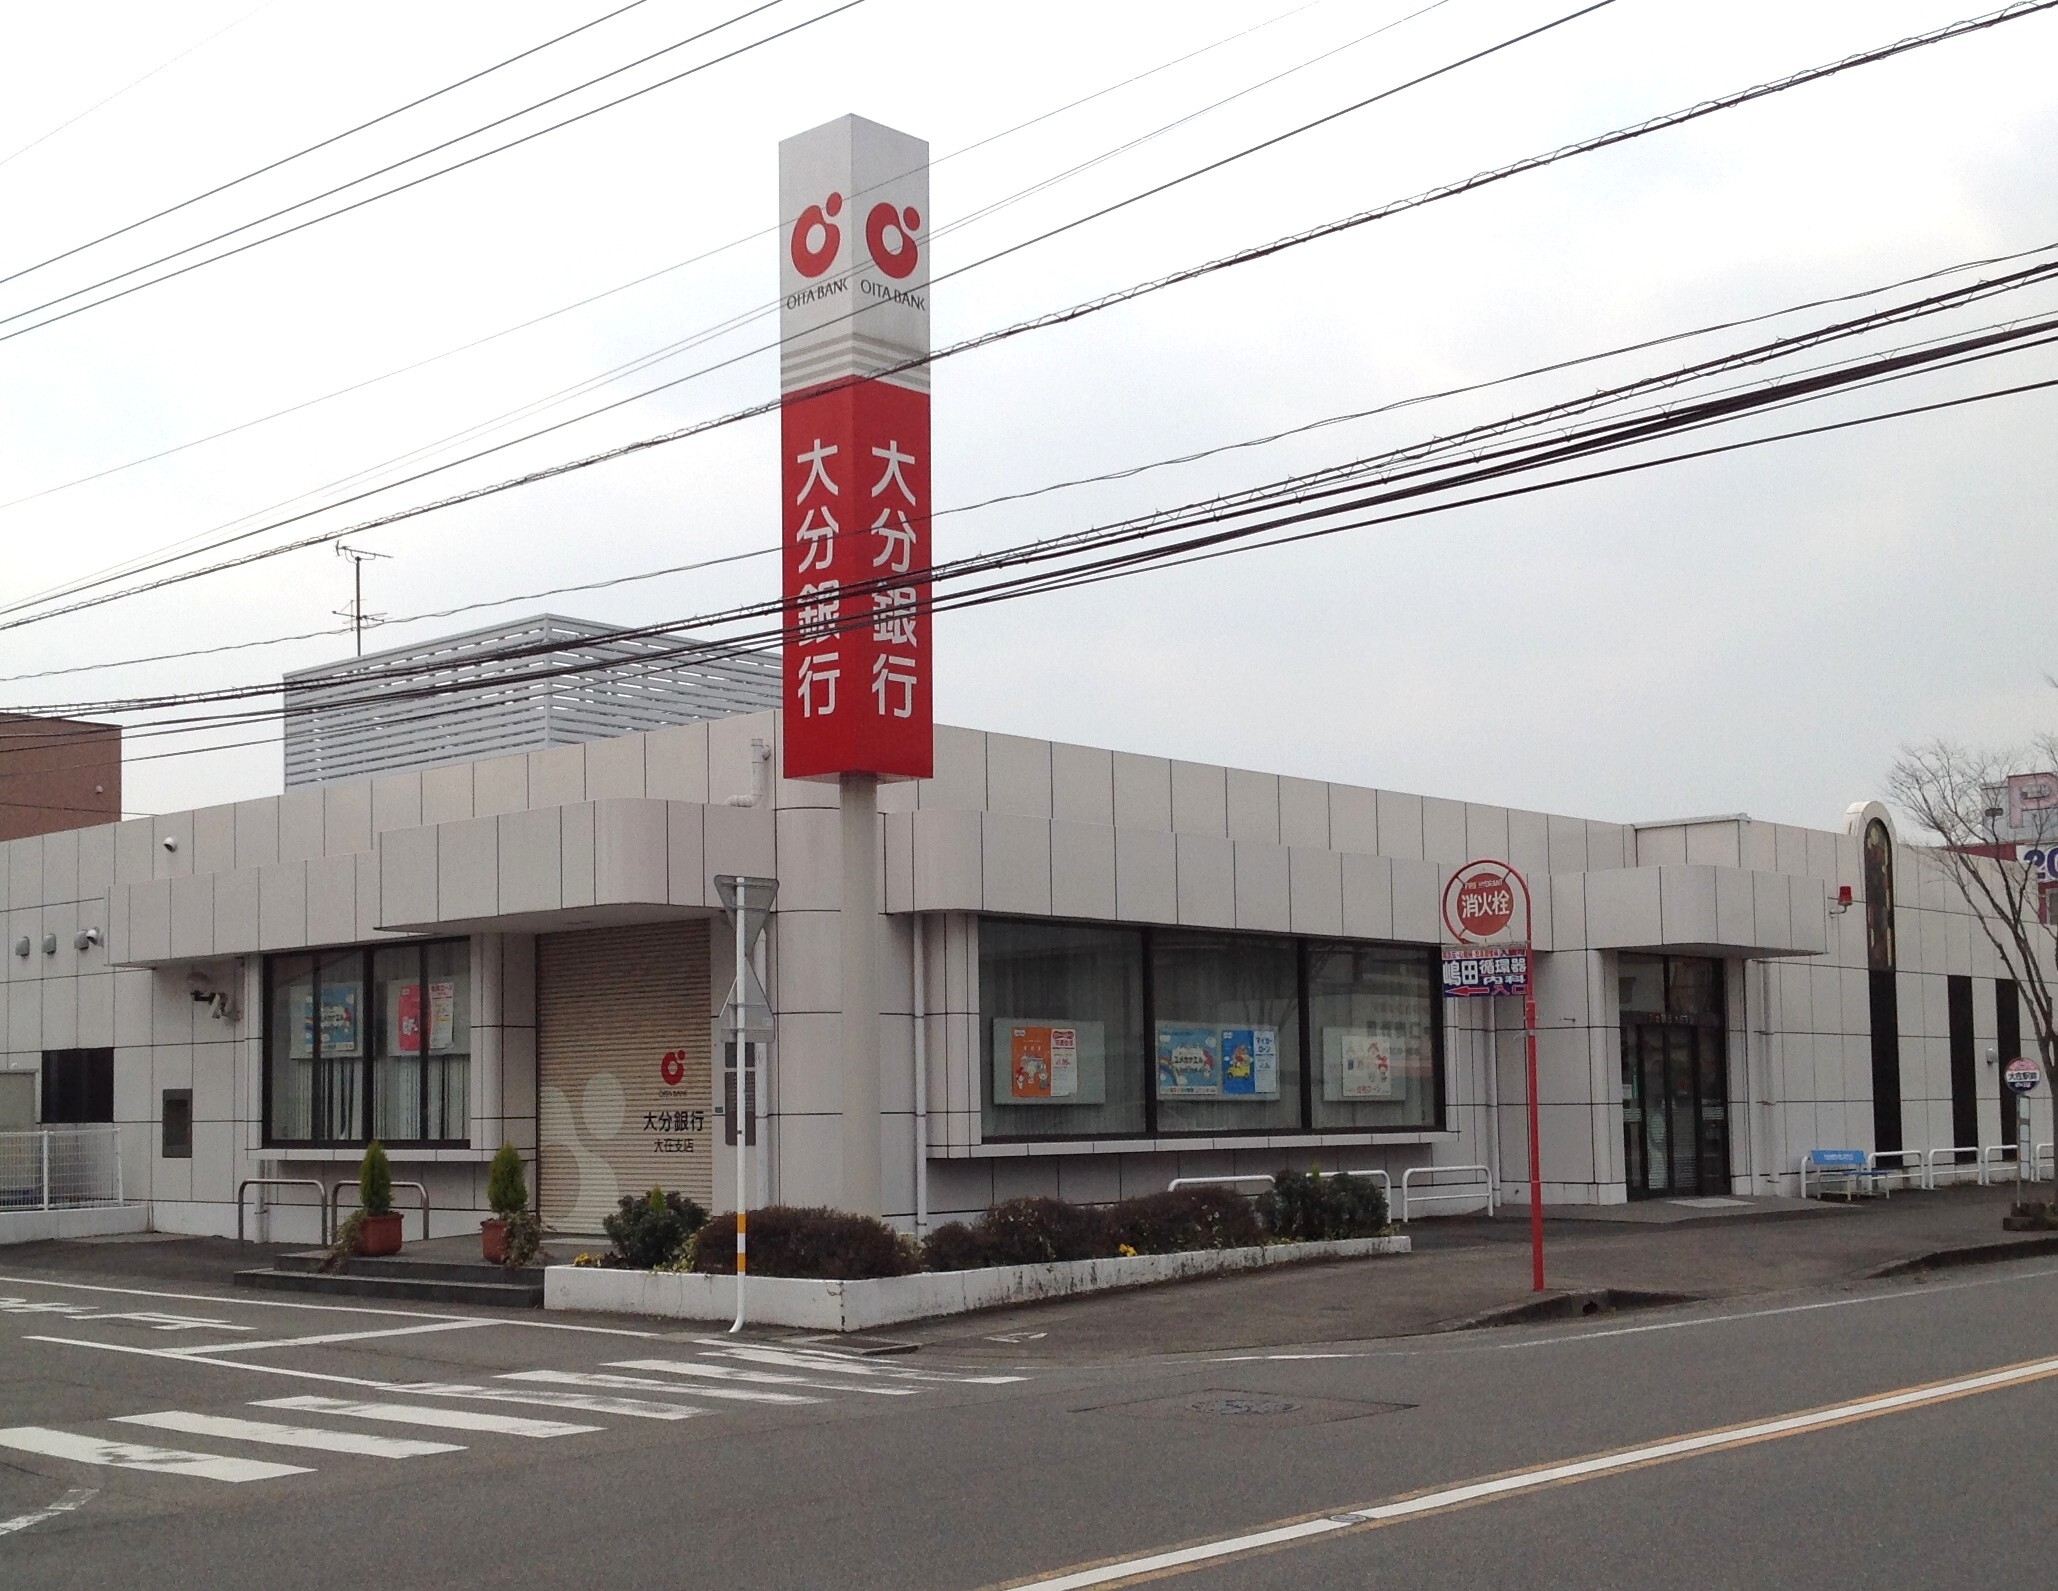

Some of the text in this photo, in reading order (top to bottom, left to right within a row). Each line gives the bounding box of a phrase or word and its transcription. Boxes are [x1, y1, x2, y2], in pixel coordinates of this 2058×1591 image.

[786, 278, 849, 310] OITA BANK
[860, 280, 926, 312] OITA BANK
[796, 438, 841, 719] 大分銀行
[871, 440, 917, 719] 大分銀行
[1461, 890, 1510, 918] 消火栓
[643, 1110, 705, 1132] 大分銀行
[653, 1138, 694, 1153] 大在支店
